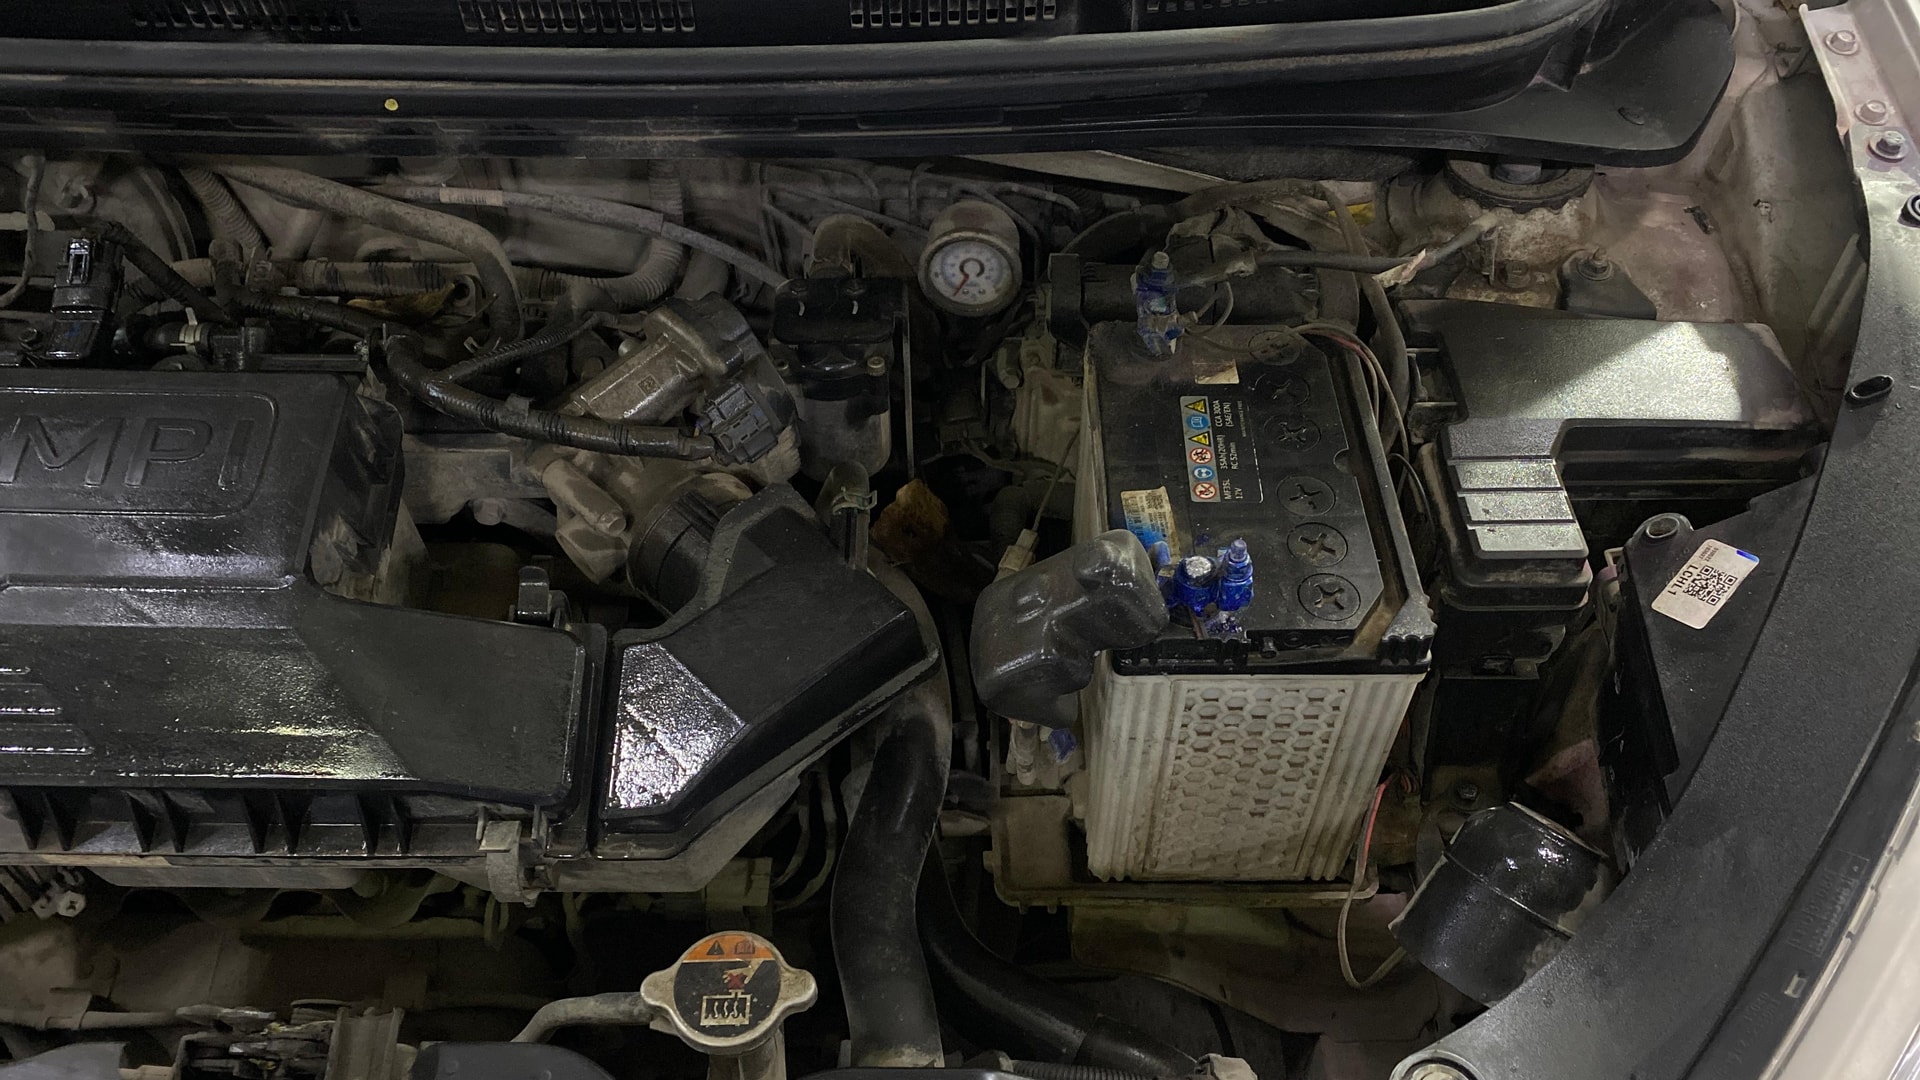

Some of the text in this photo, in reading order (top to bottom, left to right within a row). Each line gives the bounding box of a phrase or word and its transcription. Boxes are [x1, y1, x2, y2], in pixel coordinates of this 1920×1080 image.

[1212, 399, 1223, 427] CCA 300A
[0, 414, 256, 490] MPI
[1234, 487, 1244, 499] 12V
[1667, 564, 1698, 596] LCHL1
